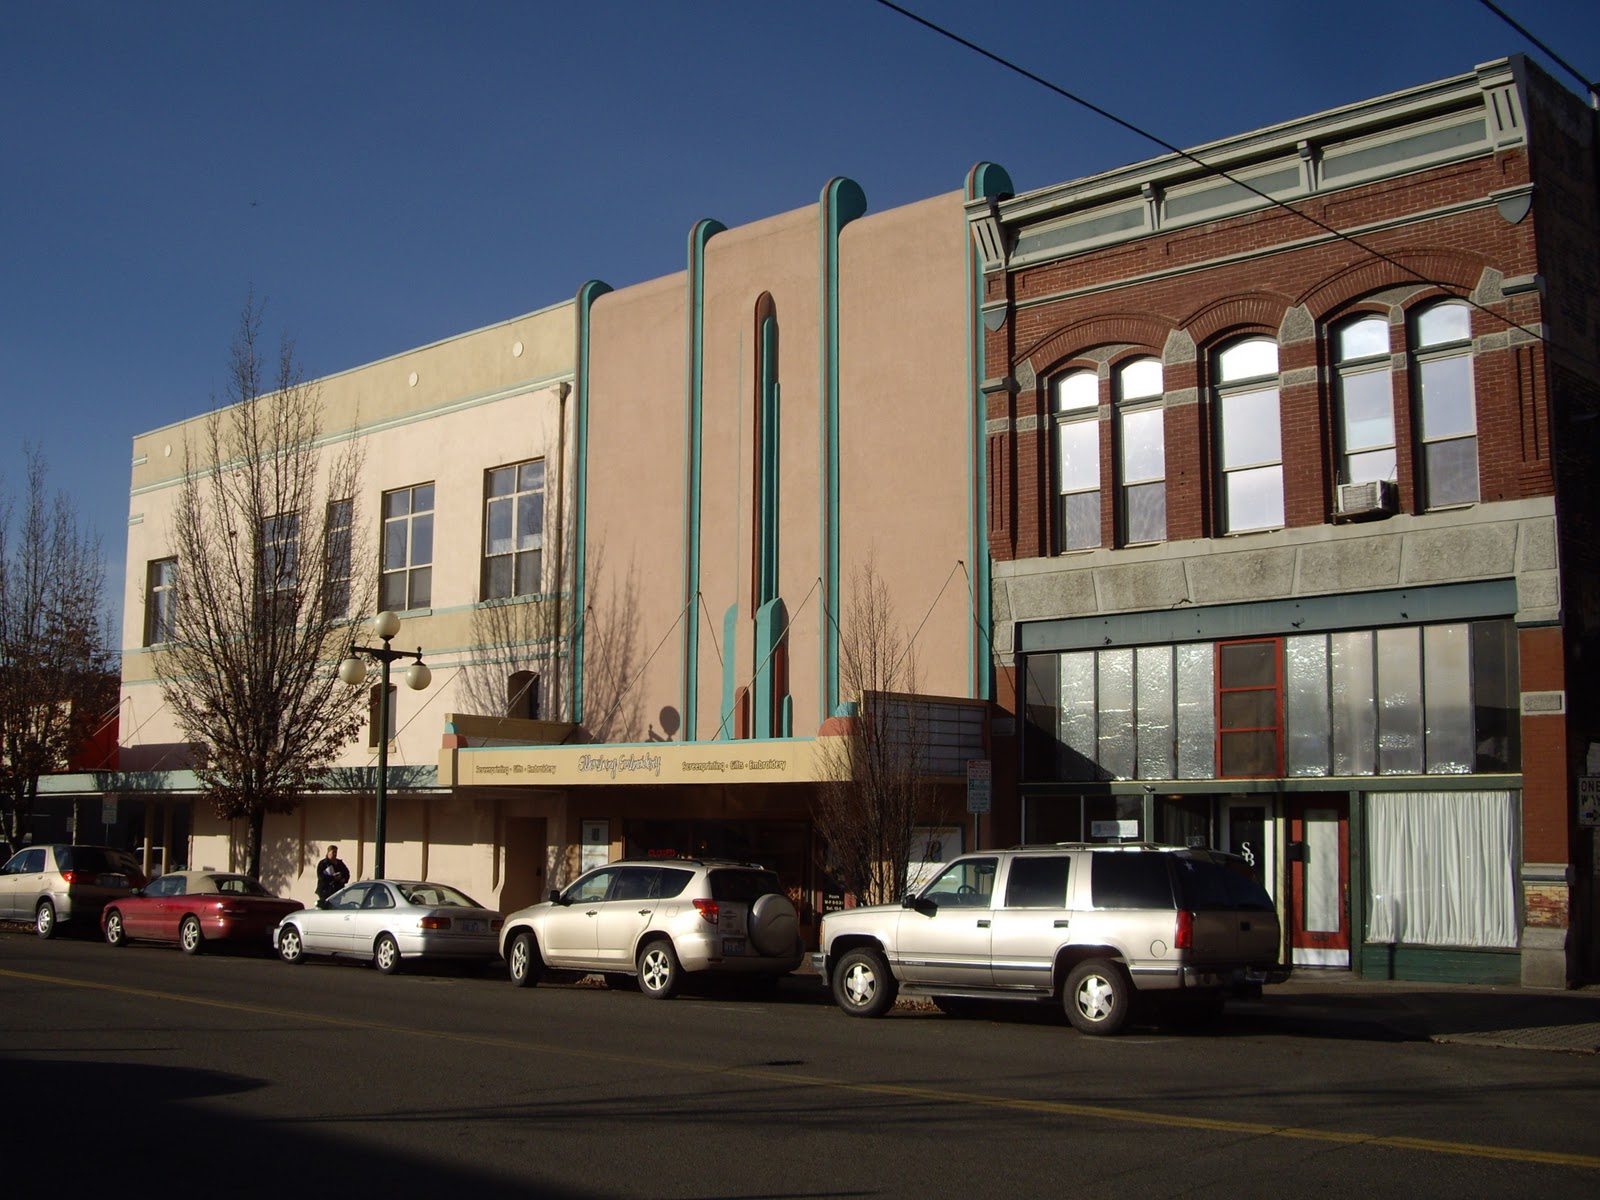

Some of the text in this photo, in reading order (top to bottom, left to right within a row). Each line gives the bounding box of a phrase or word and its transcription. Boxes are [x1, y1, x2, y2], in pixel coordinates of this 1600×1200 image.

[527, 764, 557, 774] Embroidery
[618, 752, 662, 778] Embroidery
[682, 759, 787, 773] Screenprinting Gifts Embroidery
[1581, 780, 1600, 792] ONE
